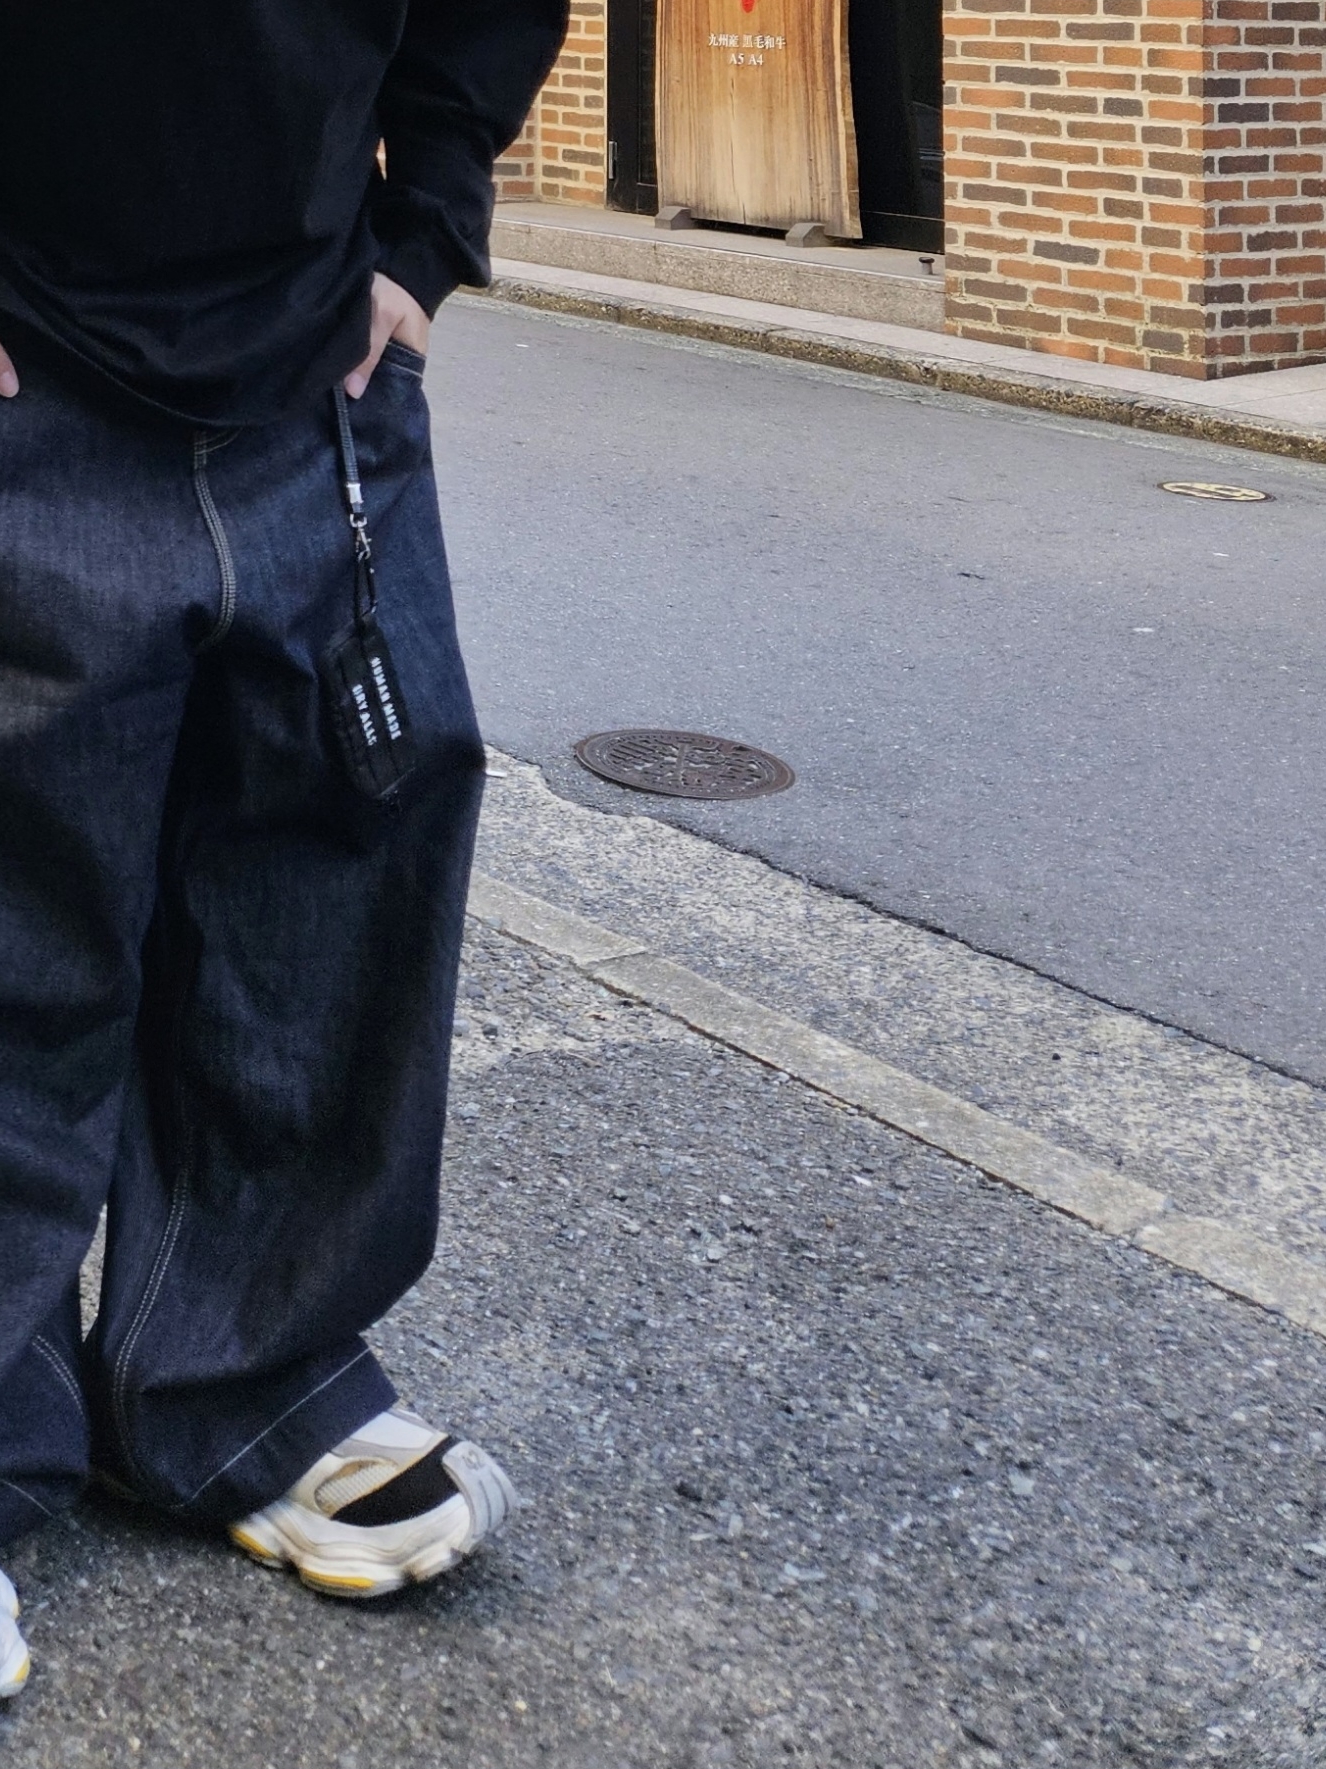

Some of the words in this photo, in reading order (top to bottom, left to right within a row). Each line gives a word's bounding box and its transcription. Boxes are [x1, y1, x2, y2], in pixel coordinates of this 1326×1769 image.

[729, 53, 745, 65] A5
[748, 54, 764, 66] A4
[370, 656, 391, 703] HUMAN
[383, 703, 402, 740] MADE
